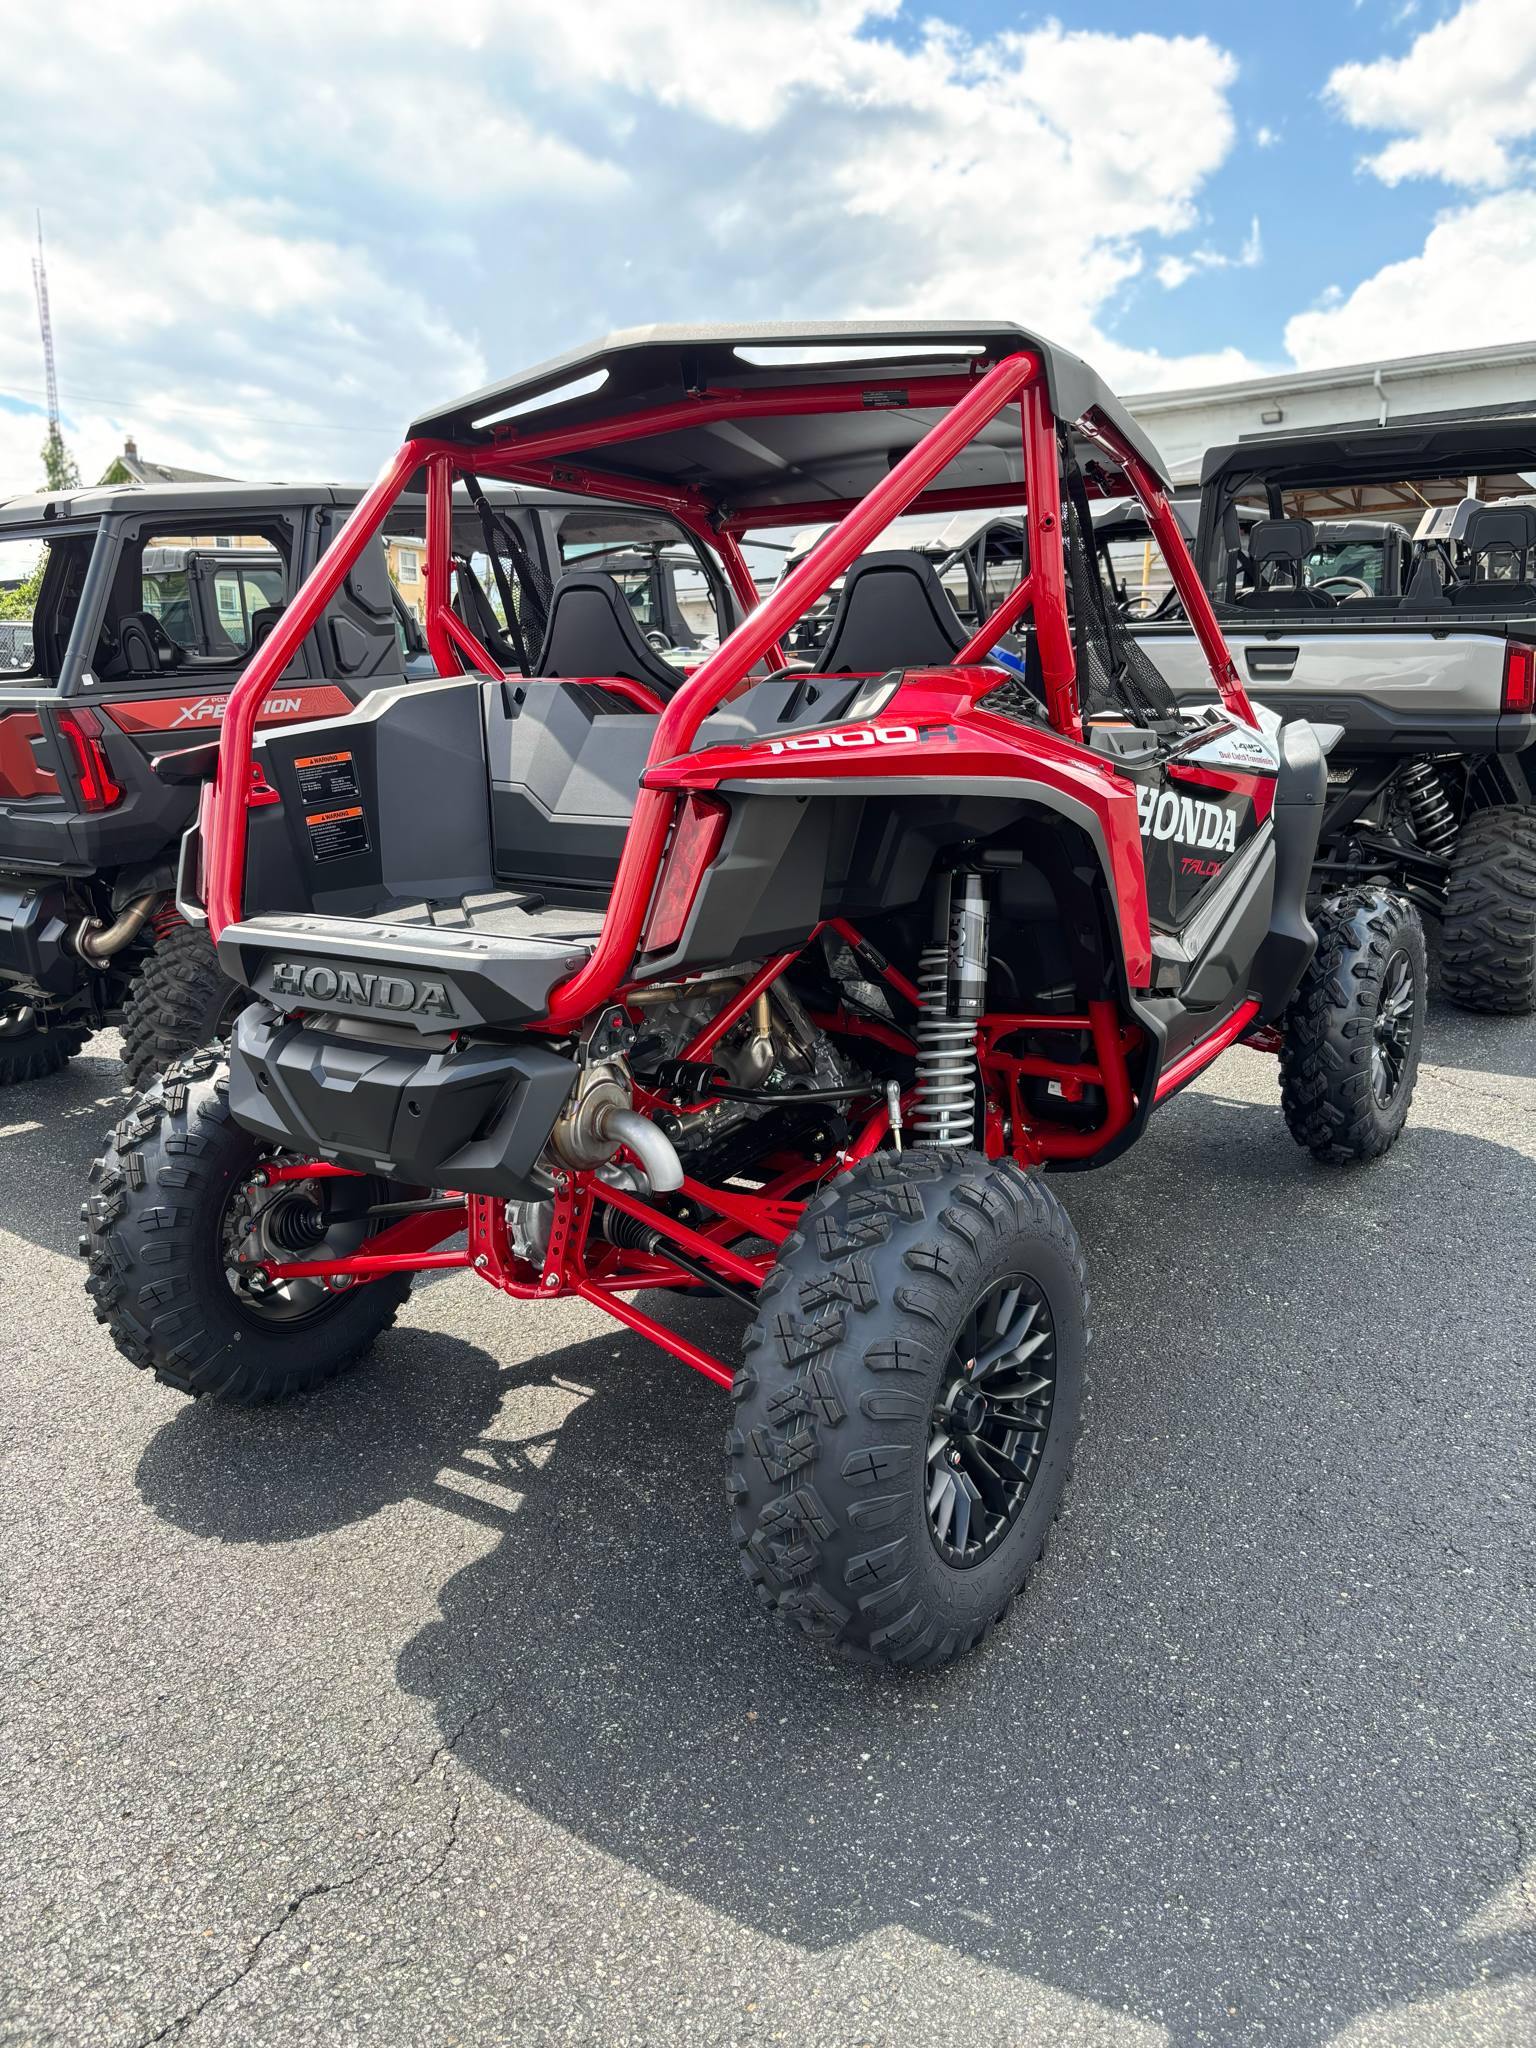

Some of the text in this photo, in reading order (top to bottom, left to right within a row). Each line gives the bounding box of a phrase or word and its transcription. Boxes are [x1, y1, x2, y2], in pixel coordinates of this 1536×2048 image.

[169, 698, 302, 727] XPEION
[314, 755, 338, 764] WARNING
[326, 811, 350, 820] WARNING
[1136, 784, 1237, 853] HONDA
[269, 962, 460, 1020] HONDA
